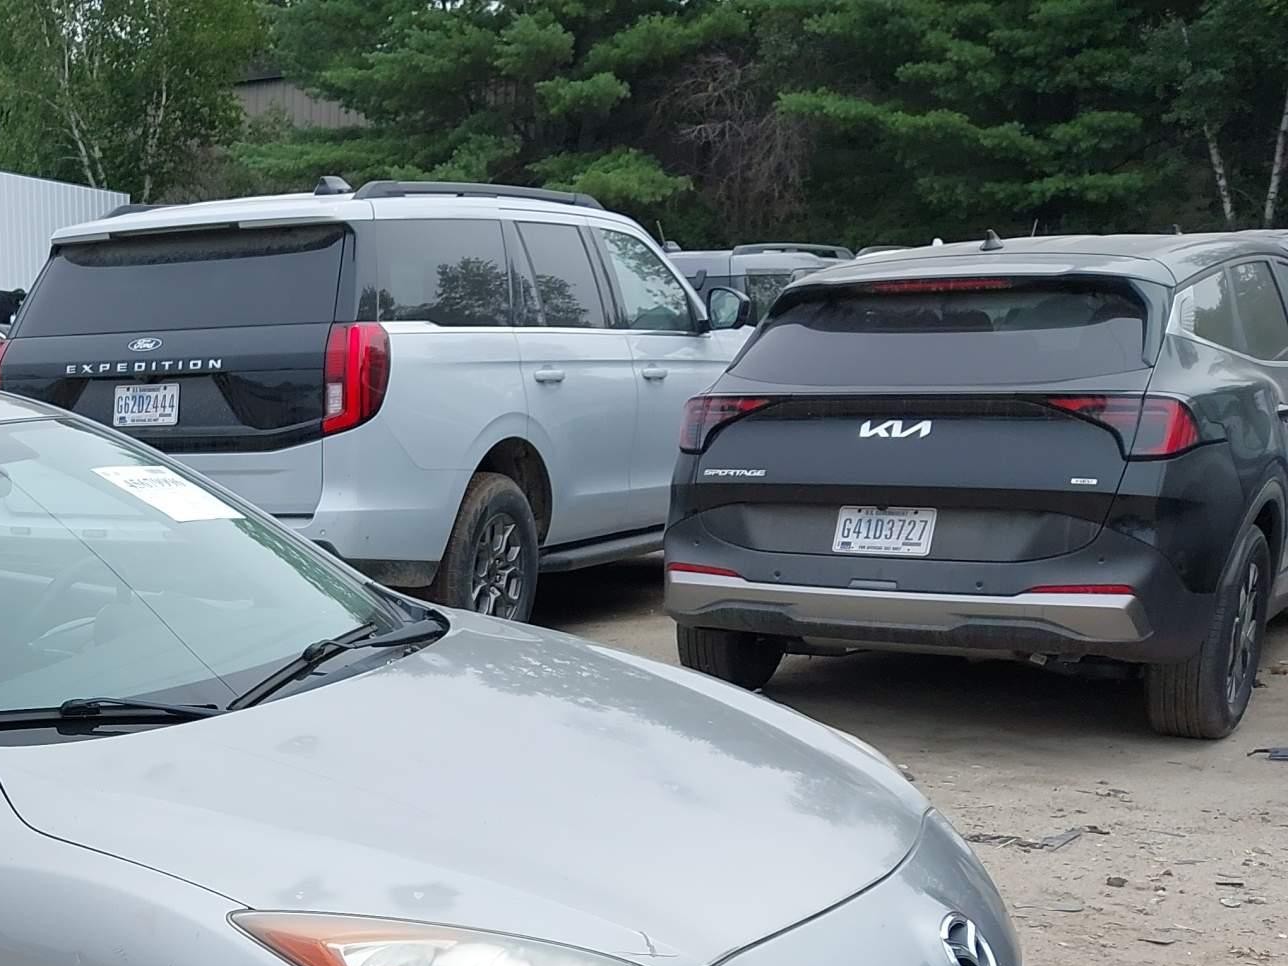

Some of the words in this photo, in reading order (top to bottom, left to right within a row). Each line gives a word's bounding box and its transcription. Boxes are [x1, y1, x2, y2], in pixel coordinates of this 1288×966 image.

[132, 338, 157, 350] Ford
[66, 359, 222, 374] EXPEDITION
[117, 393, 175, 414] G62D2444
[859, 419, 932, 438] KIA
[704, 469, 766, 477] SPORTAGE
[841, 518, 928, 541] G41D3727
